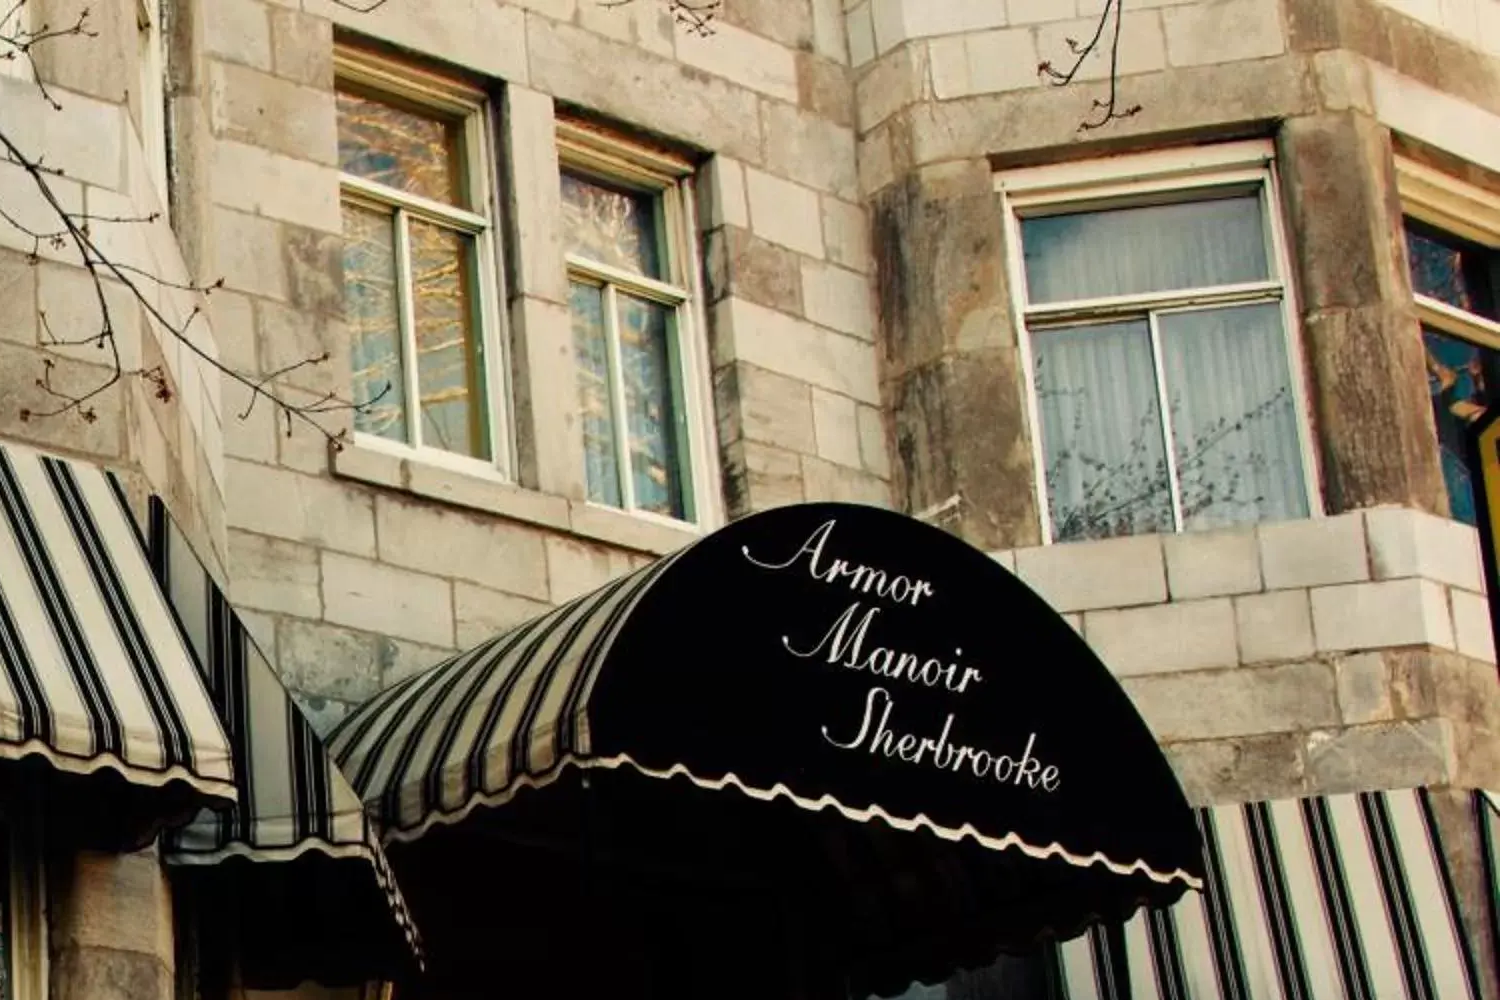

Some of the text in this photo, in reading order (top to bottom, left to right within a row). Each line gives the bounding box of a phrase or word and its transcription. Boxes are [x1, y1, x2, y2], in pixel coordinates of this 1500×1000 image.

[741, 518, 935, 606] Armor
[781, 601, 984, 694] Manoir
[820, 686, 1062, 794] Sherbrooke
